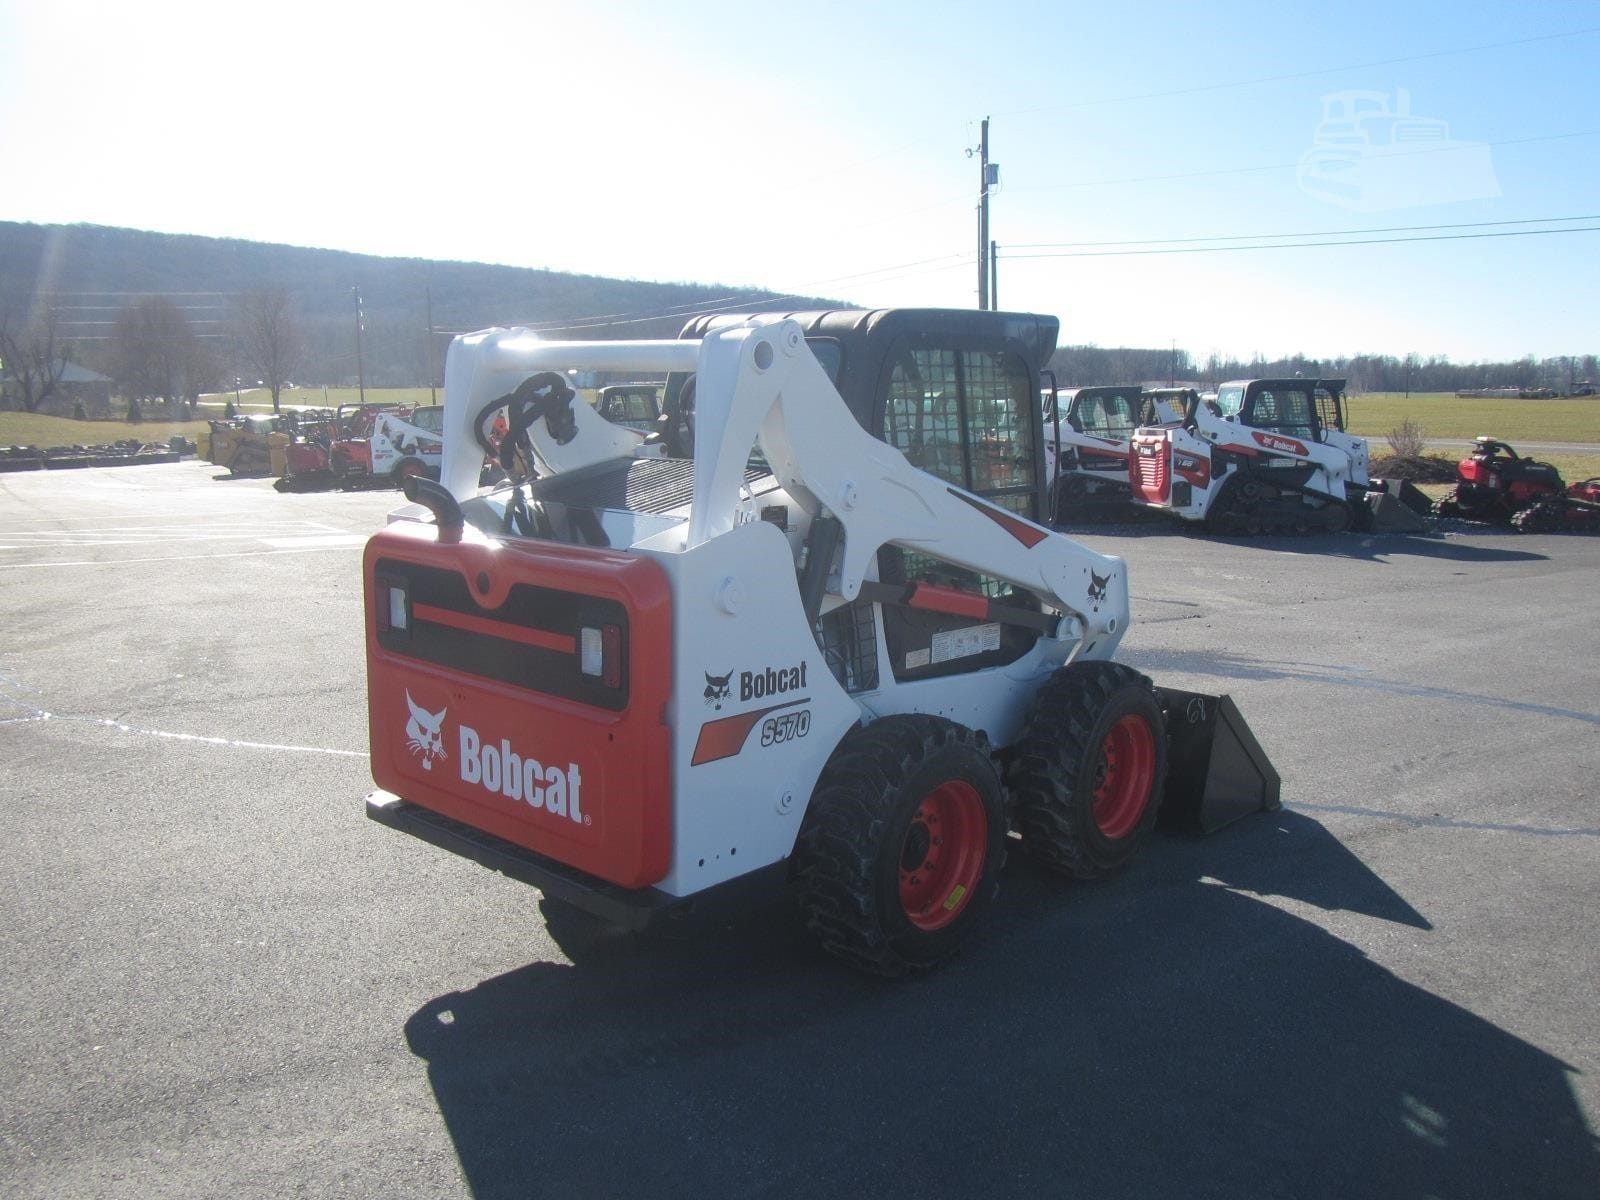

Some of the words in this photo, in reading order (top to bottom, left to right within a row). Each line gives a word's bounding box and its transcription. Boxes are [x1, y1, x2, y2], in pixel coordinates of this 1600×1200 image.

[1273, 440, 1297, 452] Bobcat
[741, 661, 806, 702] Bobcat
[761, 709, 811, 748] S570
[459, 726, 583, 824] Bobcat
